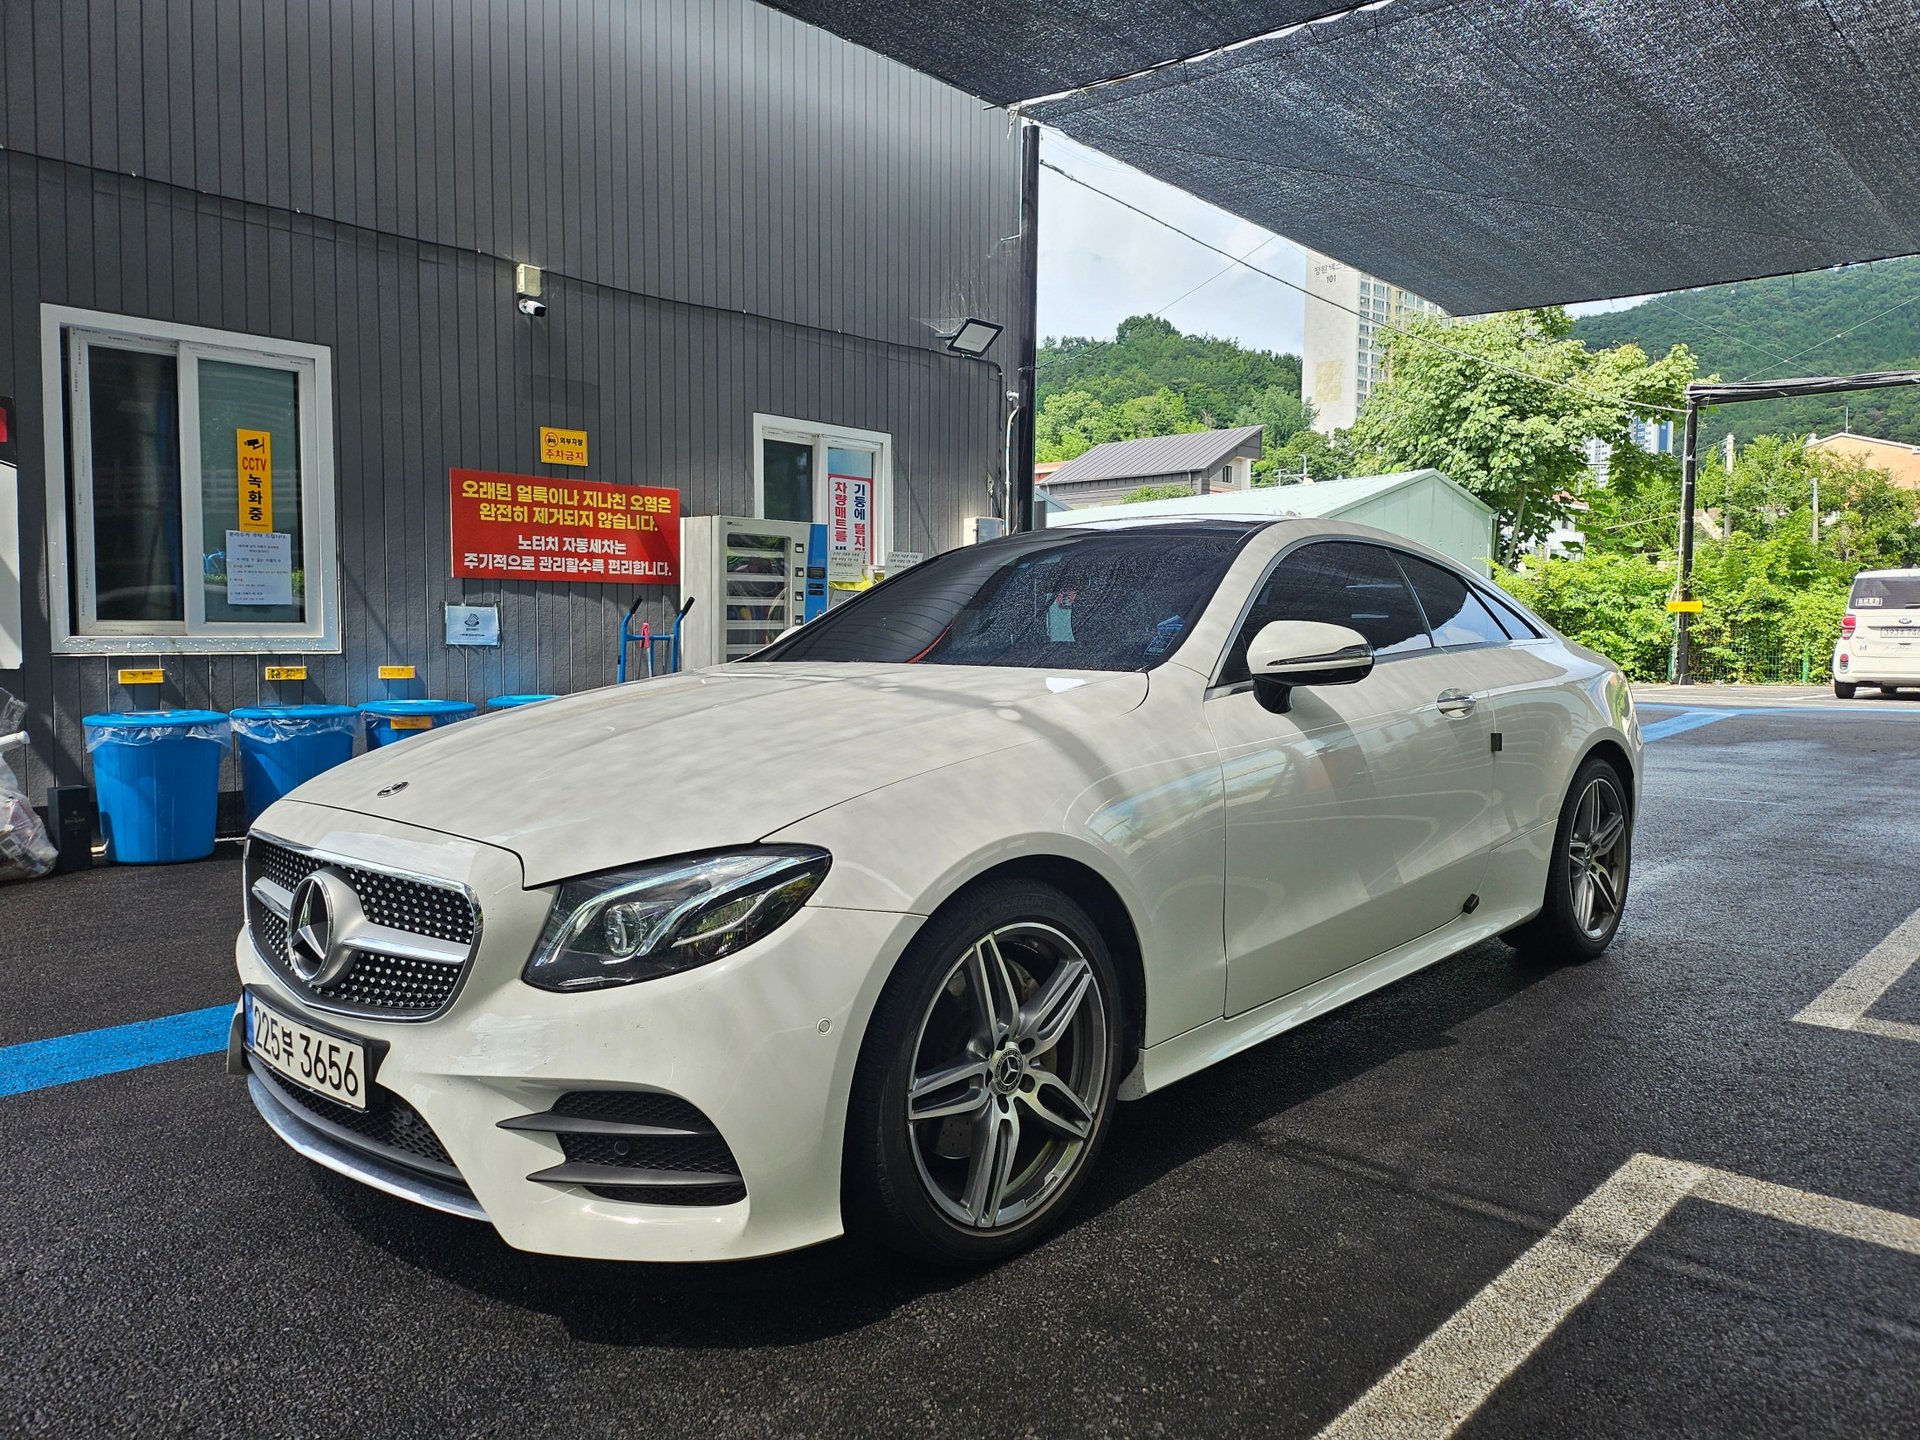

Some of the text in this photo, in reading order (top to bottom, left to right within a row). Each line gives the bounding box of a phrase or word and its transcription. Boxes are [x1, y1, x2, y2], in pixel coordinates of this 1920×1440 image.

[1326, 274, 1337, 284] 101
[242, 456, 267, 471] CCTV
[545, 448, 584, 462] 주차금지
[248, 473, 263, 521] 녹화중
[462, 480, 671, 513] 오래된 얼룩이나 지나친 오염은
[854, 484, 866, 521] 기둥에
[480, 503, 658, 531] 완전히 제거되지 않습니다.
[835, 482, 848, 543] 차량매트를
[518, 534, 627, 555] 노터치 자동세차는
[464, 552, 672, 576] 주기적으로 관리할수록 편리합니다.
[254, 1005, 358, 1097] 225부 3656
